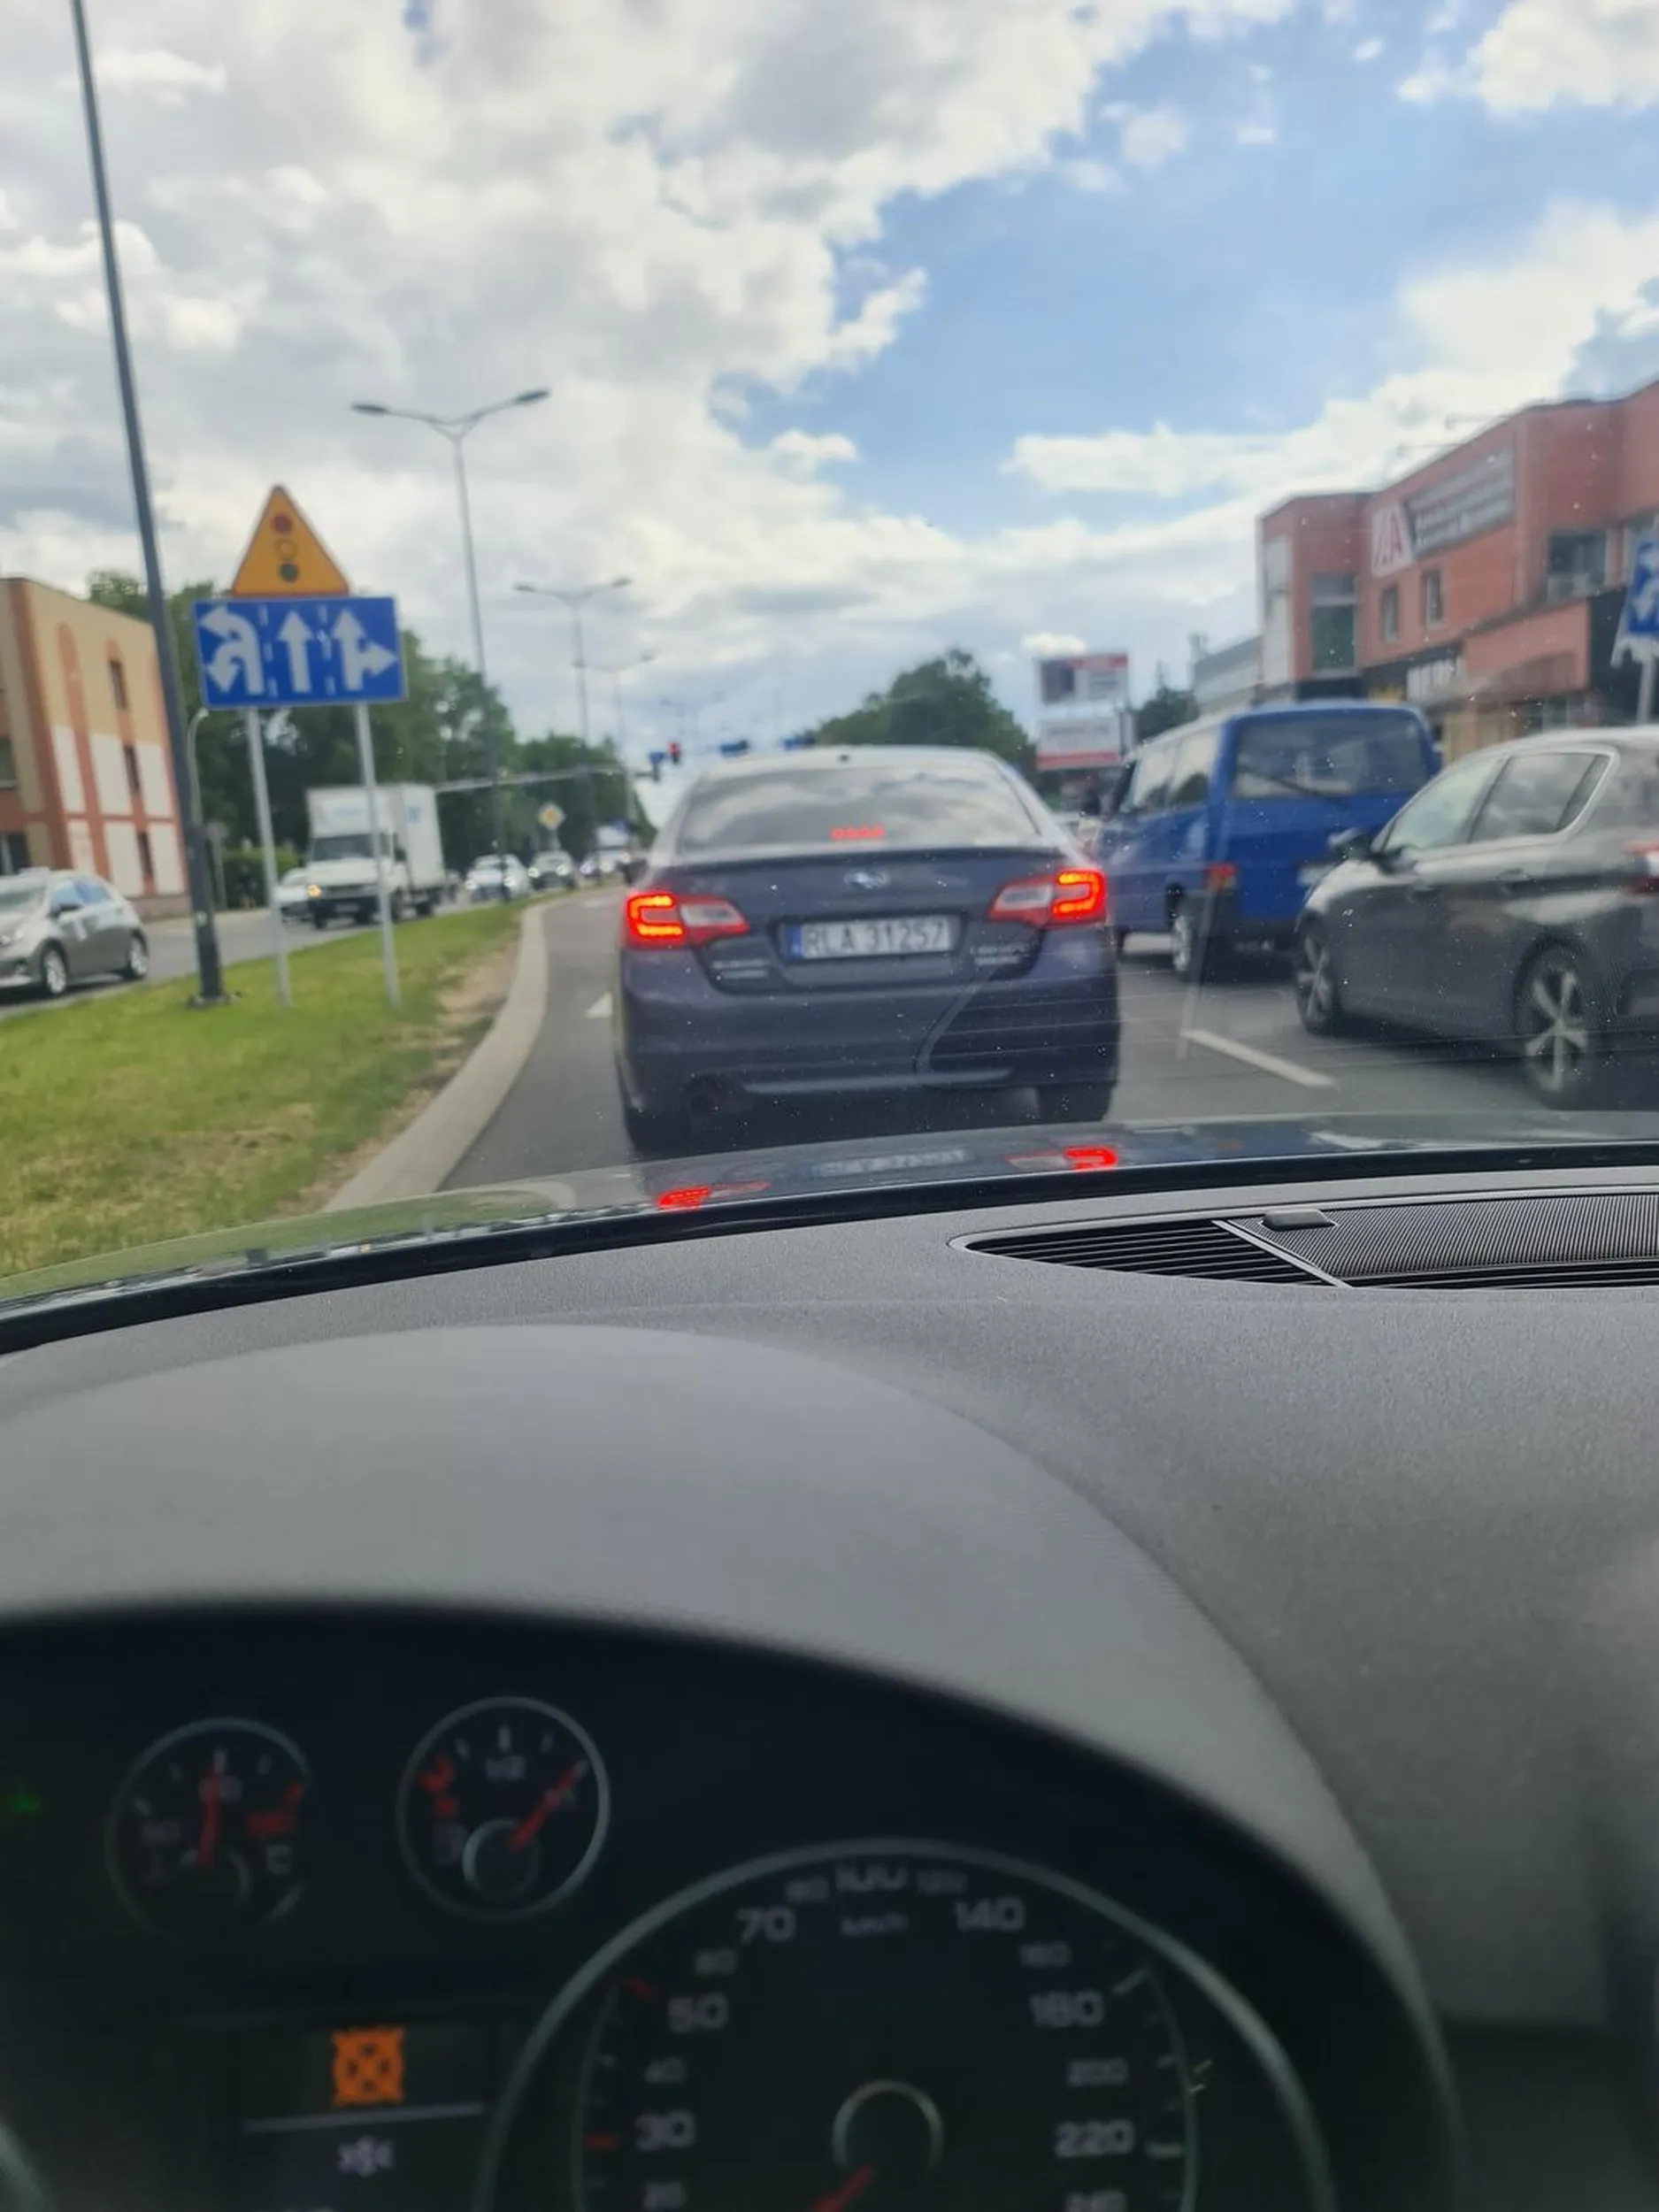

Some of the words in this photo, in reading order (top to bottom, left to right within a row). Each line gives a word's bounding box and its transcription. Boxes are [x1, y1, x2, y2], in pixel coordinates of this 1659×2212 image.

[737, 1906, 795, 1944] 70
[634, 2109, 696, 2153] 30
[1053, 2119, 1136, 2159] 220
